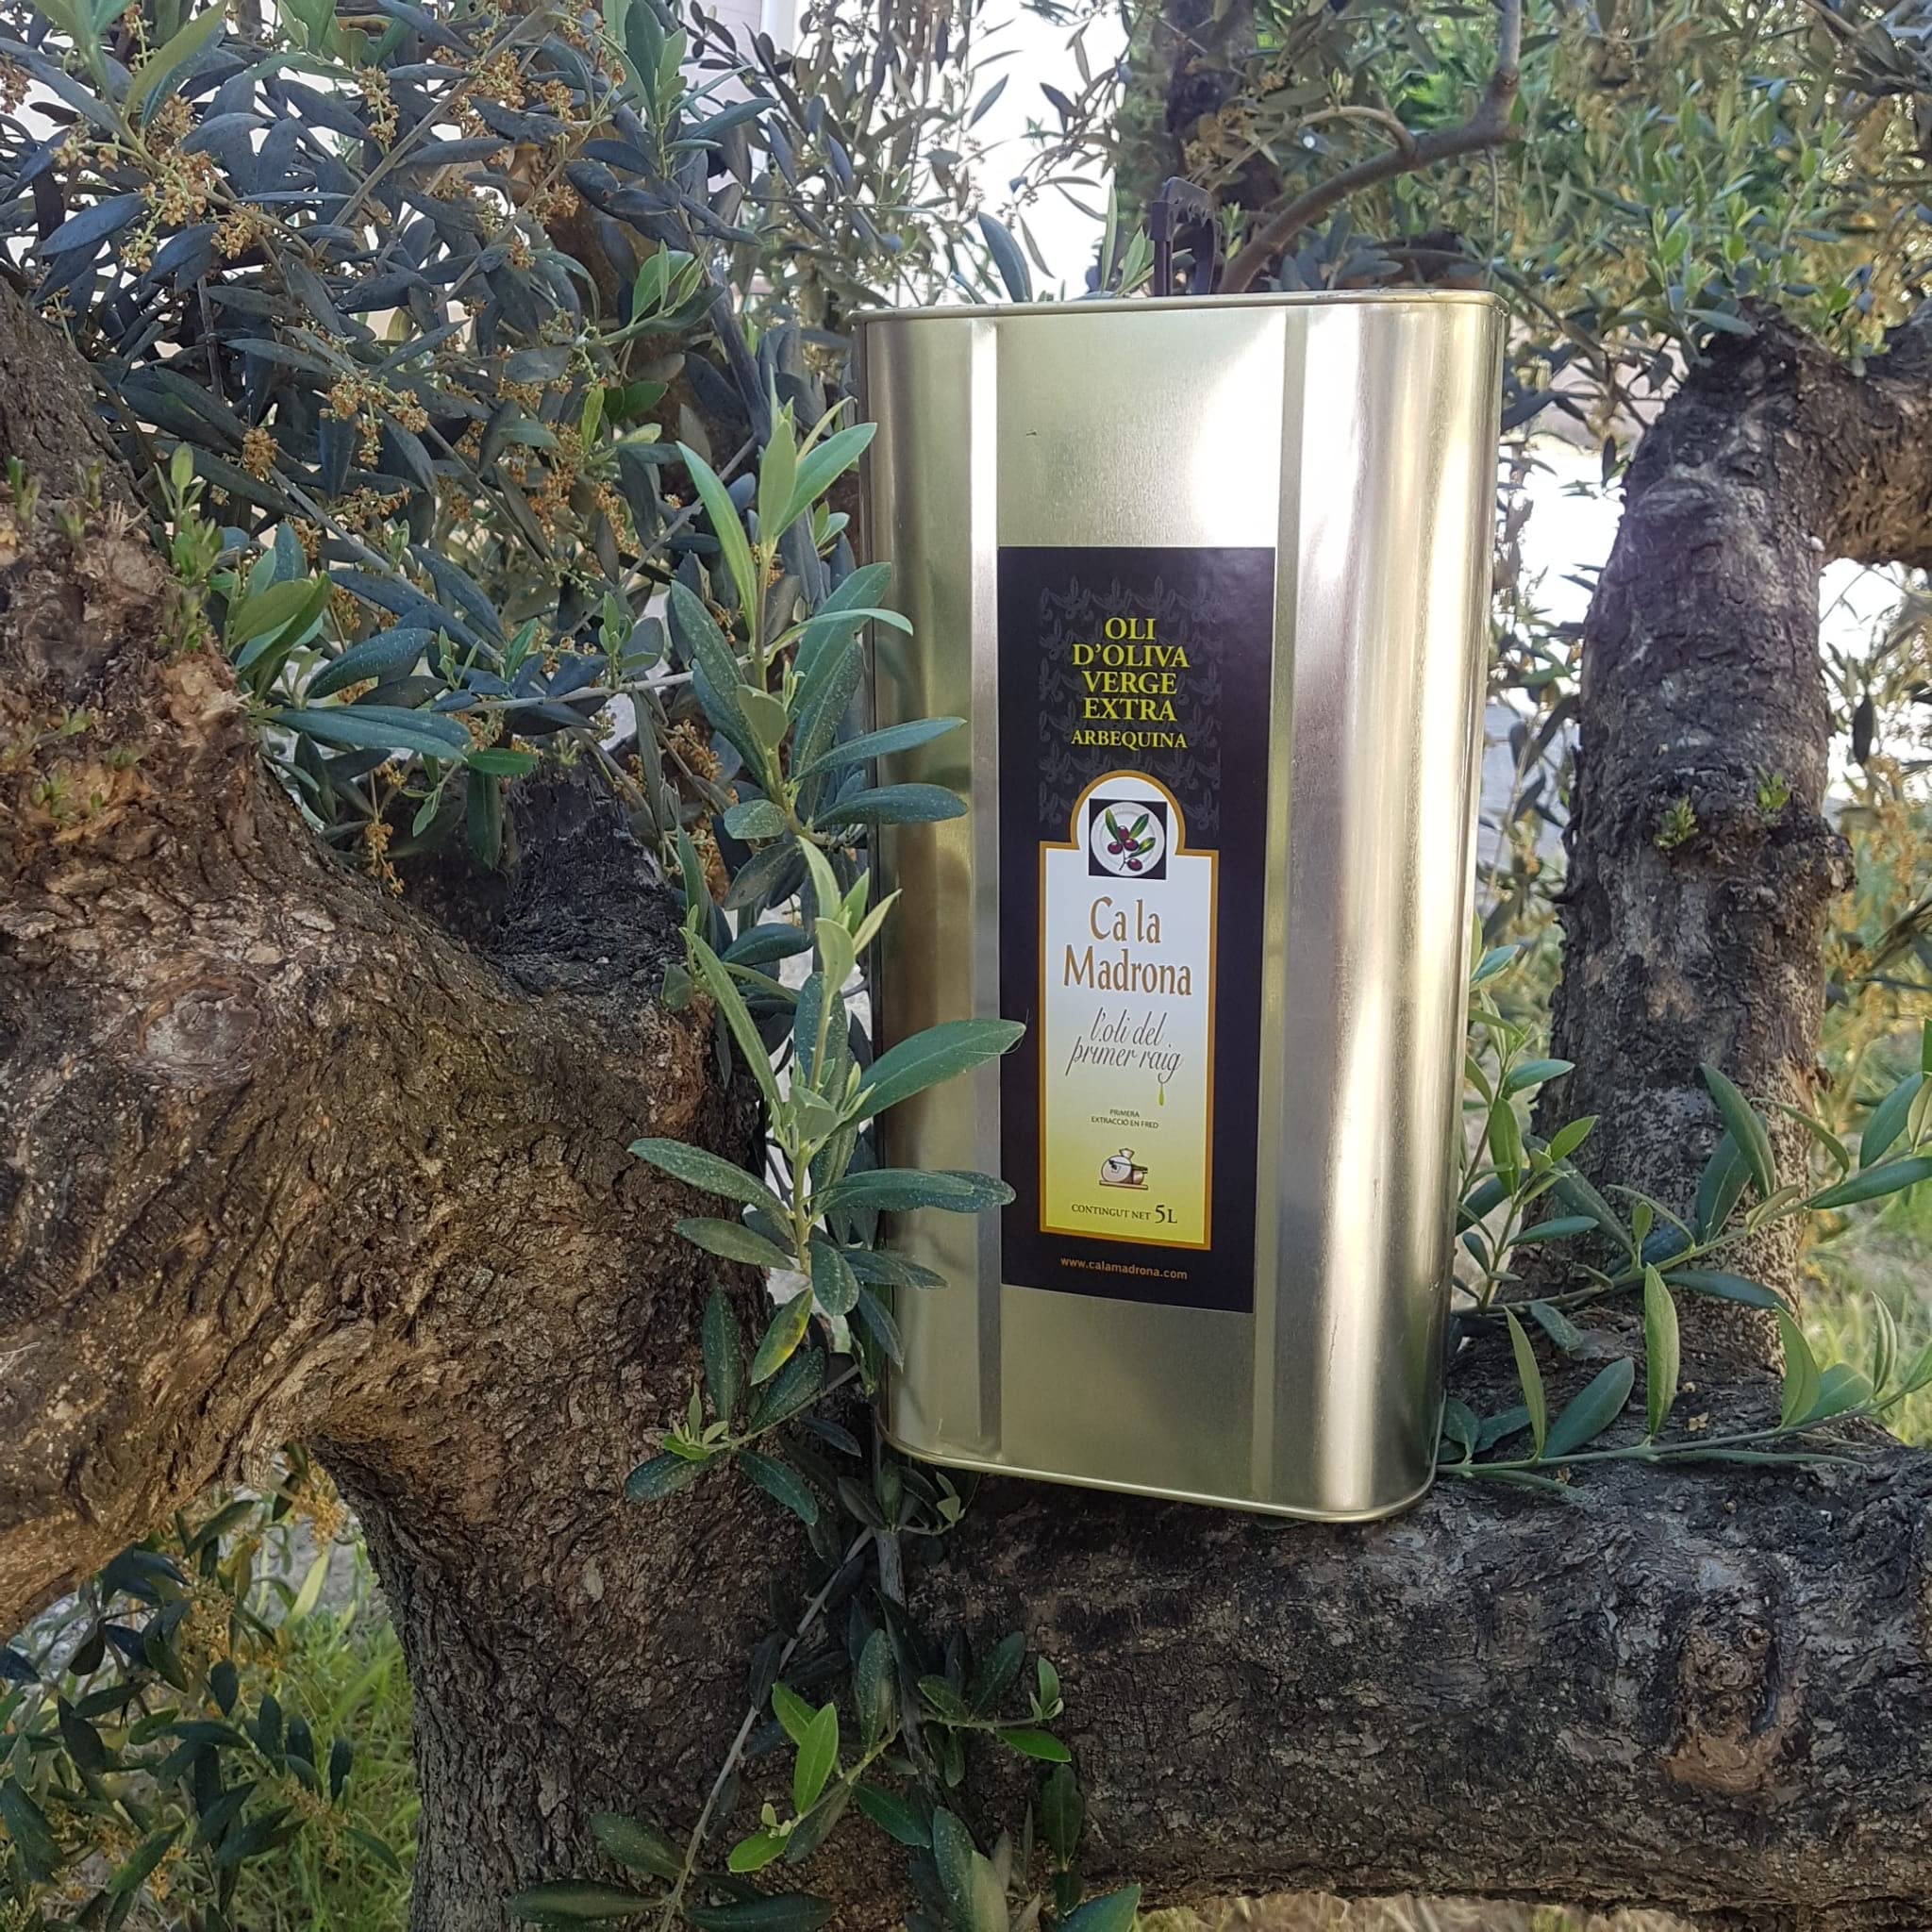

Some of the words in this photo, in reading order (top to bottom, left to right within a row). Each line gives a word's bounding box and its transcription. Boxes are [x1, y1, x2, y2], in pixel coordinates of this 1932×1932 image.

[1105, 617, 1156, 641] OLI
[1072, 642, 1191, 668] D'OLIVA
[1082, 671, 1177, 694] VERGE
[1083, 697, 1177, 722] EXTRA
[1071, 730, 1188, 750] ARBEQUINA
[1063, 944, 1191, 995] Madrona
[1132, 1011, 1167, 1046] del
[1065, 1036, 1136, 1076] primer
[1139, 1041, 1182, 1084] raig
[1109, 1108, 1140, 1118] PRIMERA
[1130, 1119, 1141, 1127] EN
[1141, 1121, 1159, 1129] FRED
[1071, 1204, 1129, 1218] CONTINGUT
[1131, 1210, 1151, 1220] NET
[1060, 1257, 1188, 1279] www.calamadrona.com
